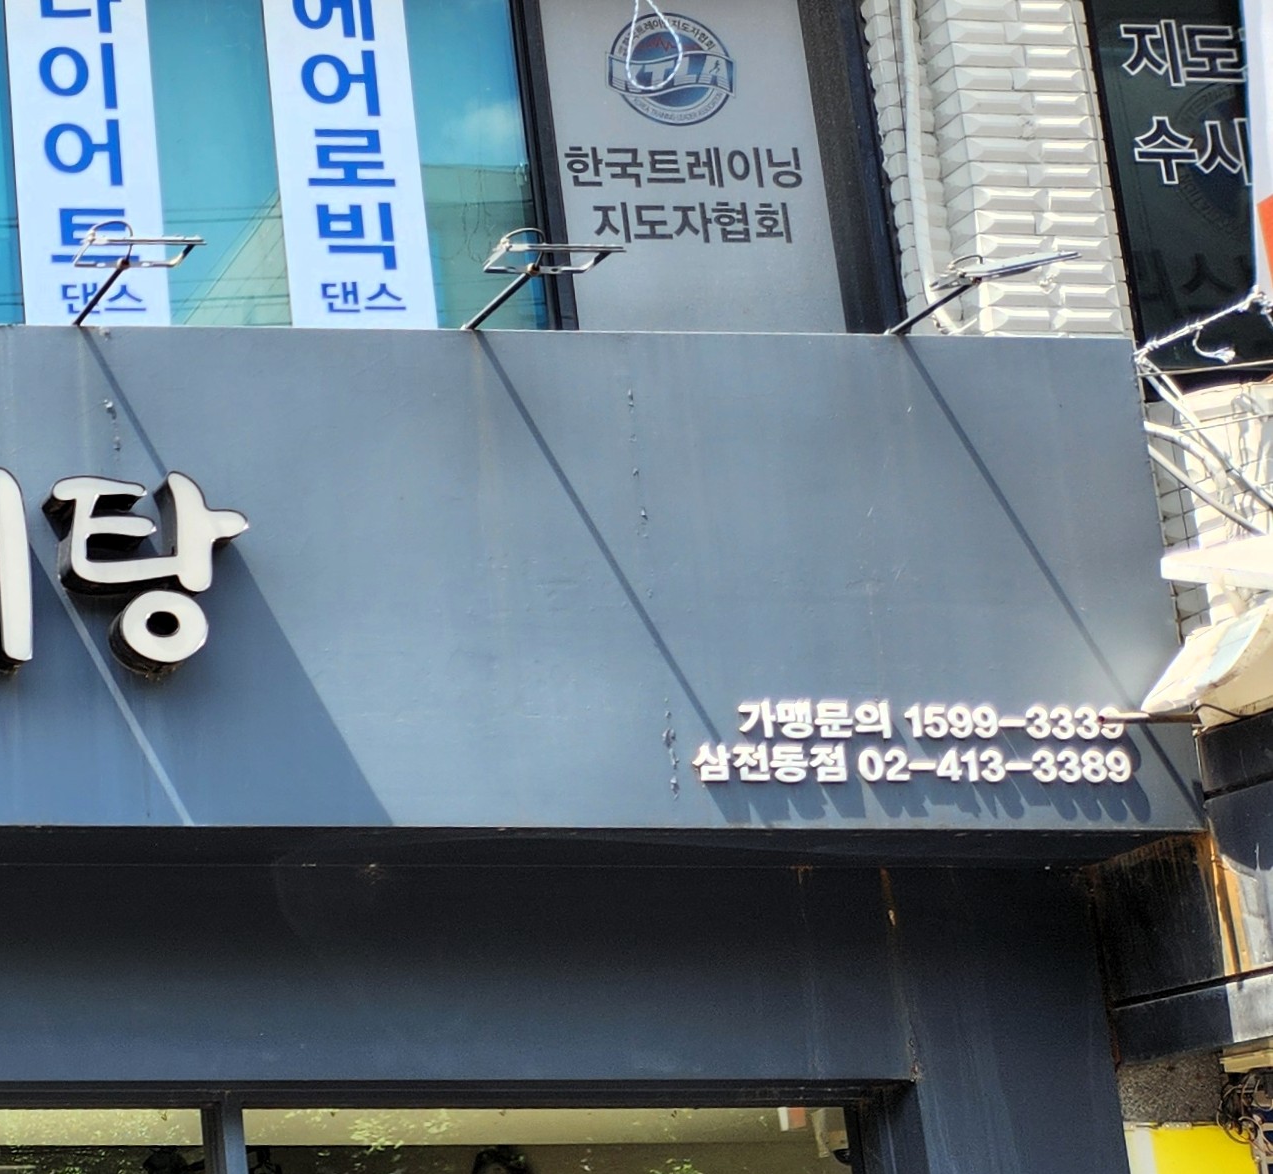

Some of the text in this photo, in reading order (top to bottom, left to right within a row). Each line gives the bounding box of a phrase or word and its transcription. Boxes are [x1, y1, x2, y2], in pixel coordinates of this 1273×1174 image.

[1120, 19, 1249, 87] 지도
[564, 146, 803, 189] 한국트레이닝
[593, 202, 793, 244] 지도자협회
[321, 281, 407, 313] 댄스
[738, 698, 893, 740] 가맹문의
[692, 742, 1133, 785] 삼전동점 02-413-3389
